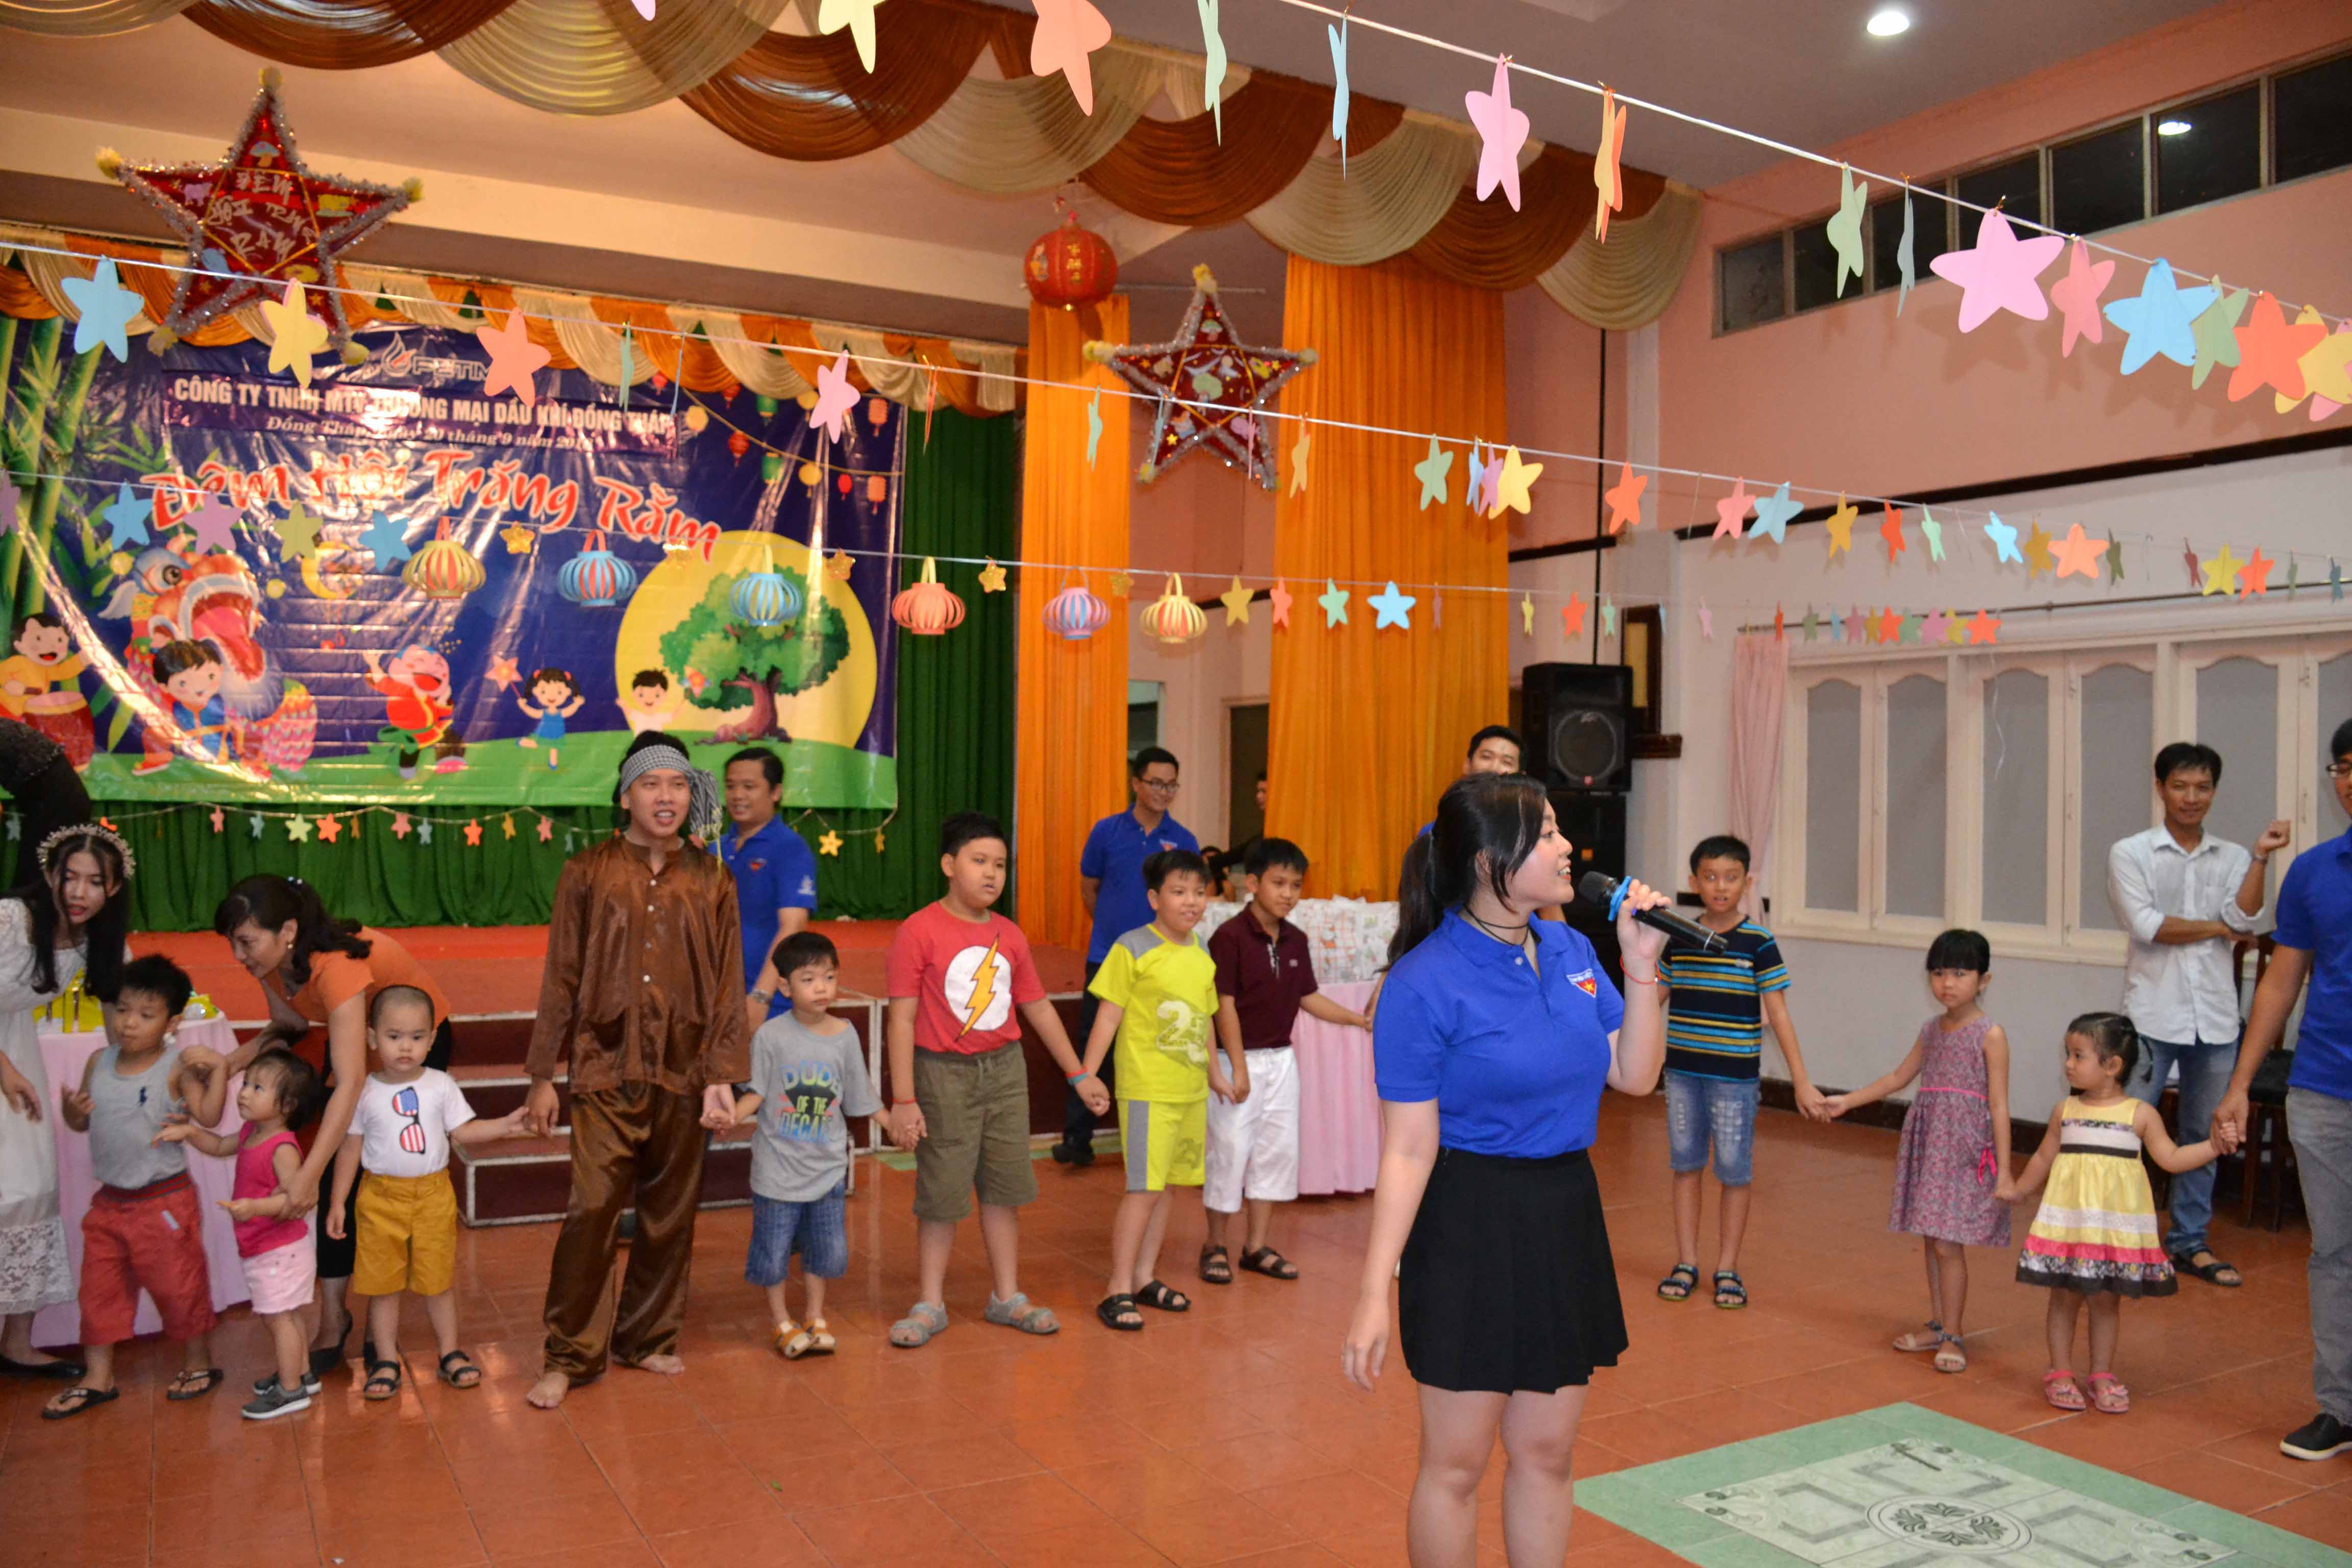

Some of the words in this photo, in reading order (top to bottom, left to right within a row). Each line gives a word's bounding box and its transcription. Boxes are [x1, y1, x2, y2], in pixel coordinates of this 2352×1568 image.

[175, 375, 233, 404] CÔNG
[237, 383, 261, 407] TY
[266, 386, 320, 411] TNHH
[324, 389, 365, 413] MTV
[452, 399, 490, 427] MẠI
[448, 429, 498, 446] tháng
[140, 460, 292, 530] Đêm
[423, 449, 578, 533] Trăng
[594, 475, 722, 562] Rằm
